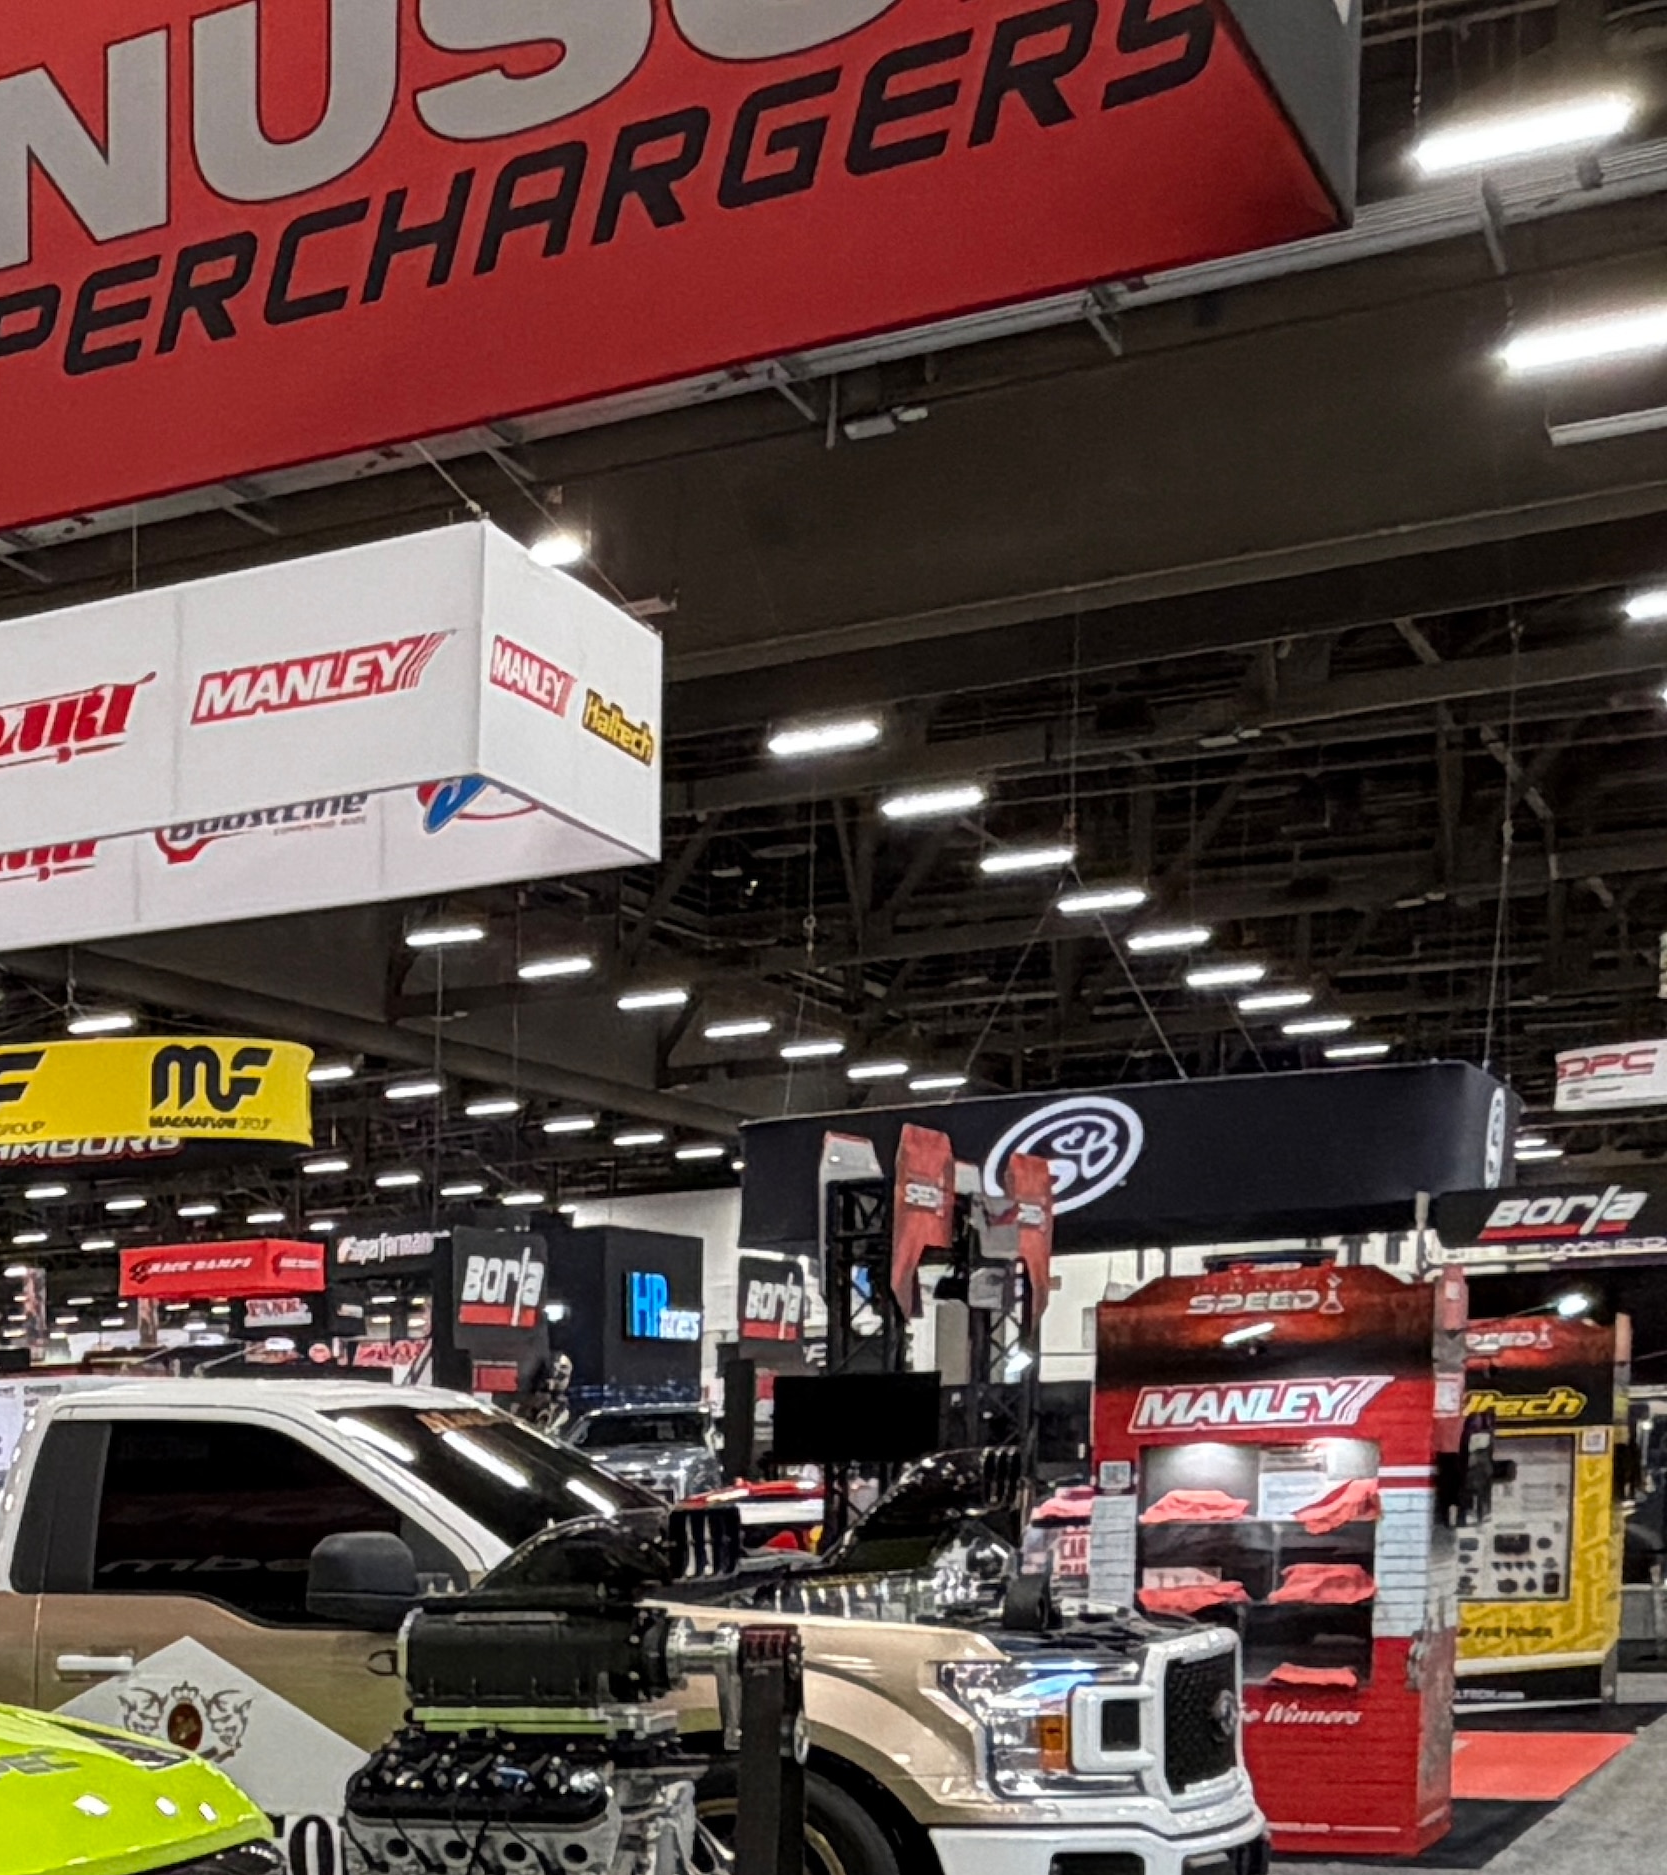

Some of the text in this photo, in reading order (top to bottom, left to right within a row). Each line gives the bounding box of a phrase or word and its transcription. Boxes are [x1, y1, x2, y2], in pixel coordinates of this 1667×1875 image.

[197, 646, 411, 718] MANLEY
[493, 639, 567, 706] MANLEY
[585, 690, 654, 762] Haltech
[1186, 1289, 1320, 1315] SPEED
[1137, 1383, 1352, 1427] MANLEY
[1263, 1700, 1363, 1725] Winners
